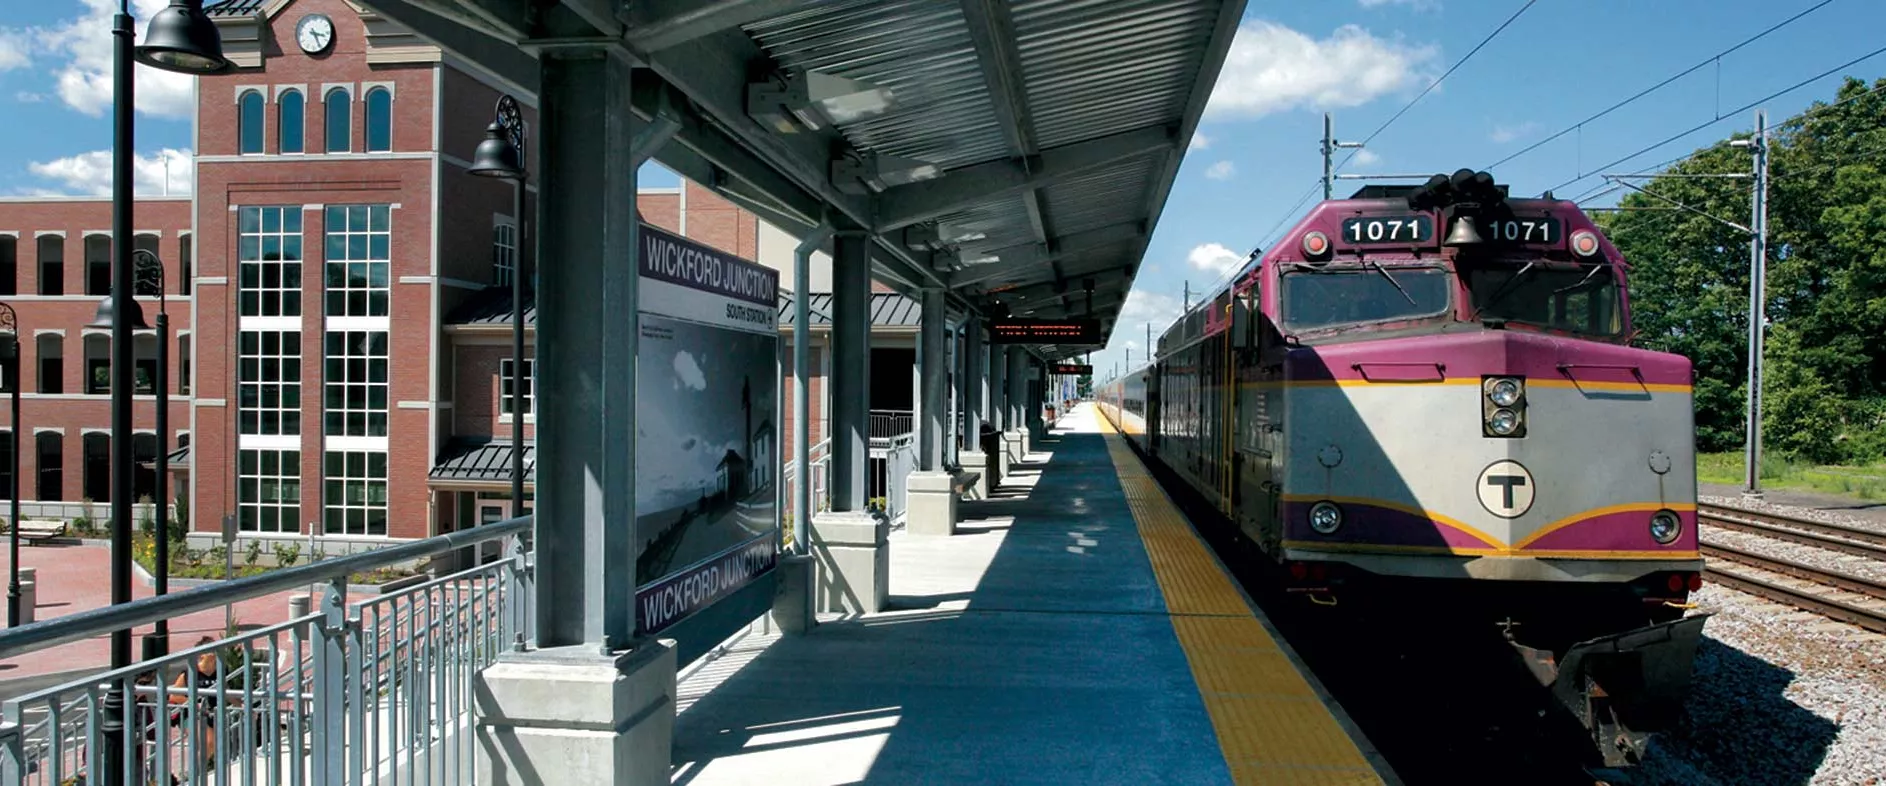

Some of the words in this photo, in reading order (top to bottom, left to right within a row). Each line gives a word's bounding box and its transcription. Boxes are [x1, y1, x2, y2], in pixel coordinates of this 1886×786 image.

[1349, 220, 1419, 241] 1071
[1489, 221, 1550, 242] 1071
[646, 235, 722, 287] WICKFORD
[723, 262, 775, 302] JUNCTION
[726, 303, 746, 321] SOUTH
[746, 307, 767, 324] STATION
[1487, 475, 1526, 509] T
[644, 566, 719, 631] WICKFORD
[721, 541, 773, 590] JUNCTION
